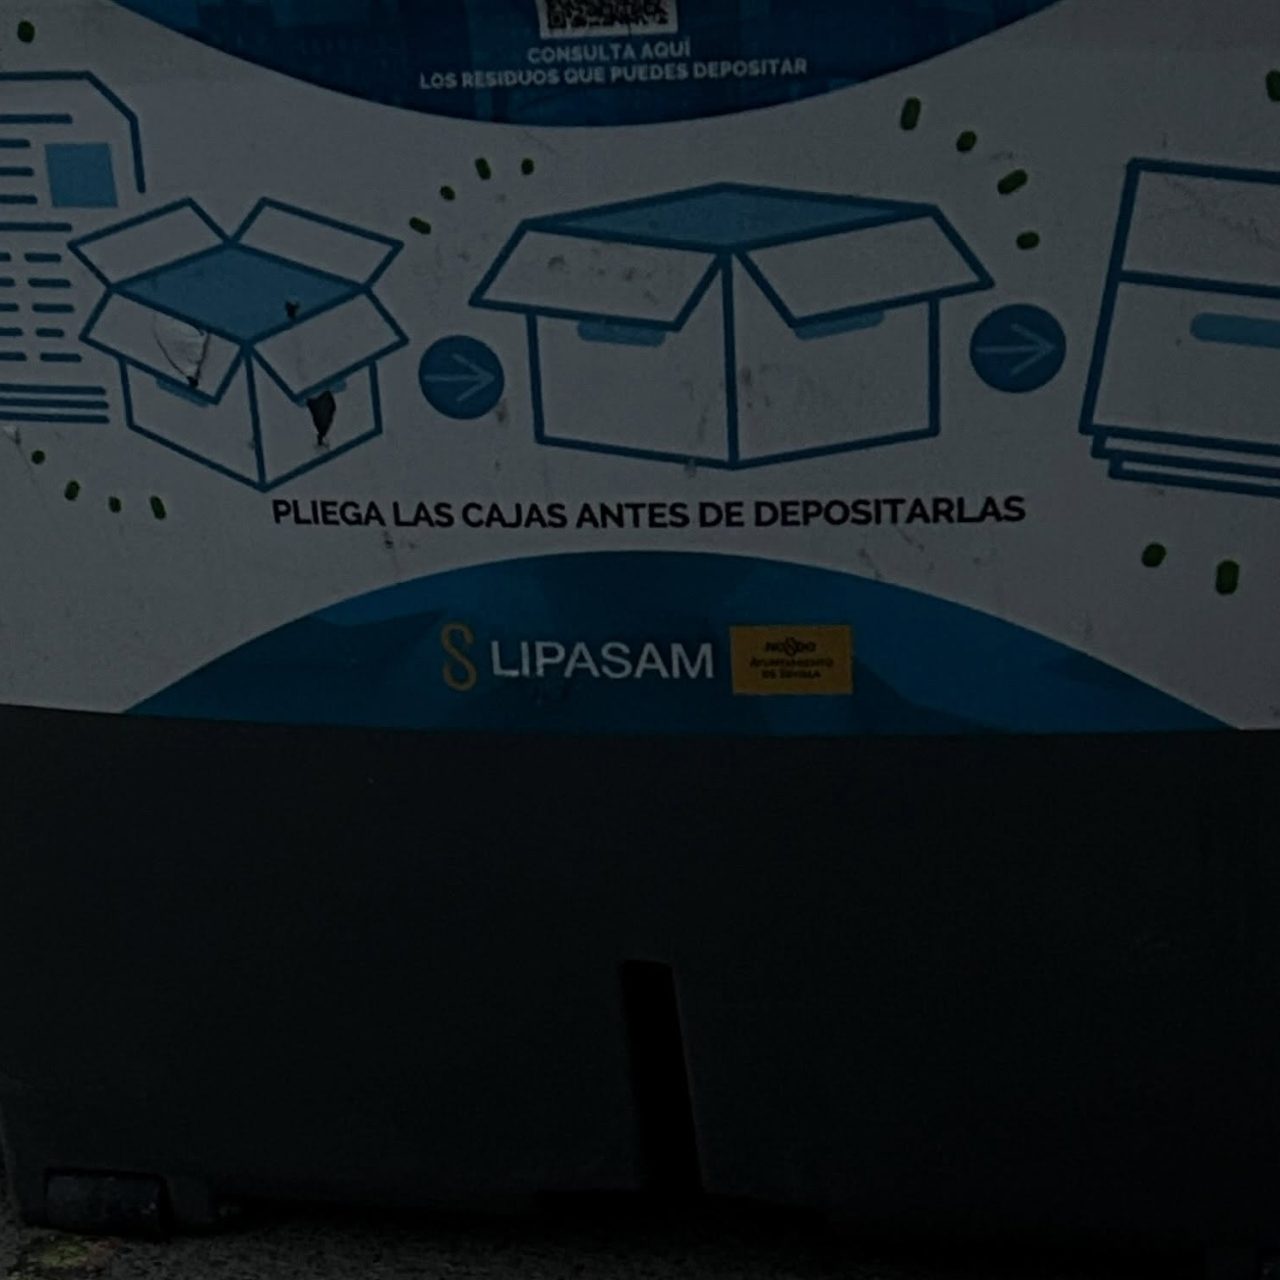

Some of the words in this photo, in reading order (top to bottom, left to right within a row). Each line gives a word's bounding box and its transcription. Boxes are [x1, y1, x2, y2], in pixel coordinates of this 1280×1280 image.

[527, 42, 636, 65] CONSULTA
[641, 35, 691, 59] AQUÍ
[419, 73, 457, 90] LOS
[462, 69, 559, 88] RESIDUOS
[563, 67, 606, 85] QUE
[610, 64, 688, 83] PUEDES
[692, 58, 807, 79] DEPOSITAR
[272, 500, 386, 525] PLIEGA
[393, 502, 455, 527] LAS
[461, 503, 567, 528] CAJAS
[576, 502, 689, 528] ANTES
[699, 502, 744, 527] DE
[755, 496, 1025, 527] DEPOSITARLAS
[490, 639, 714, 679] LIPASAM
